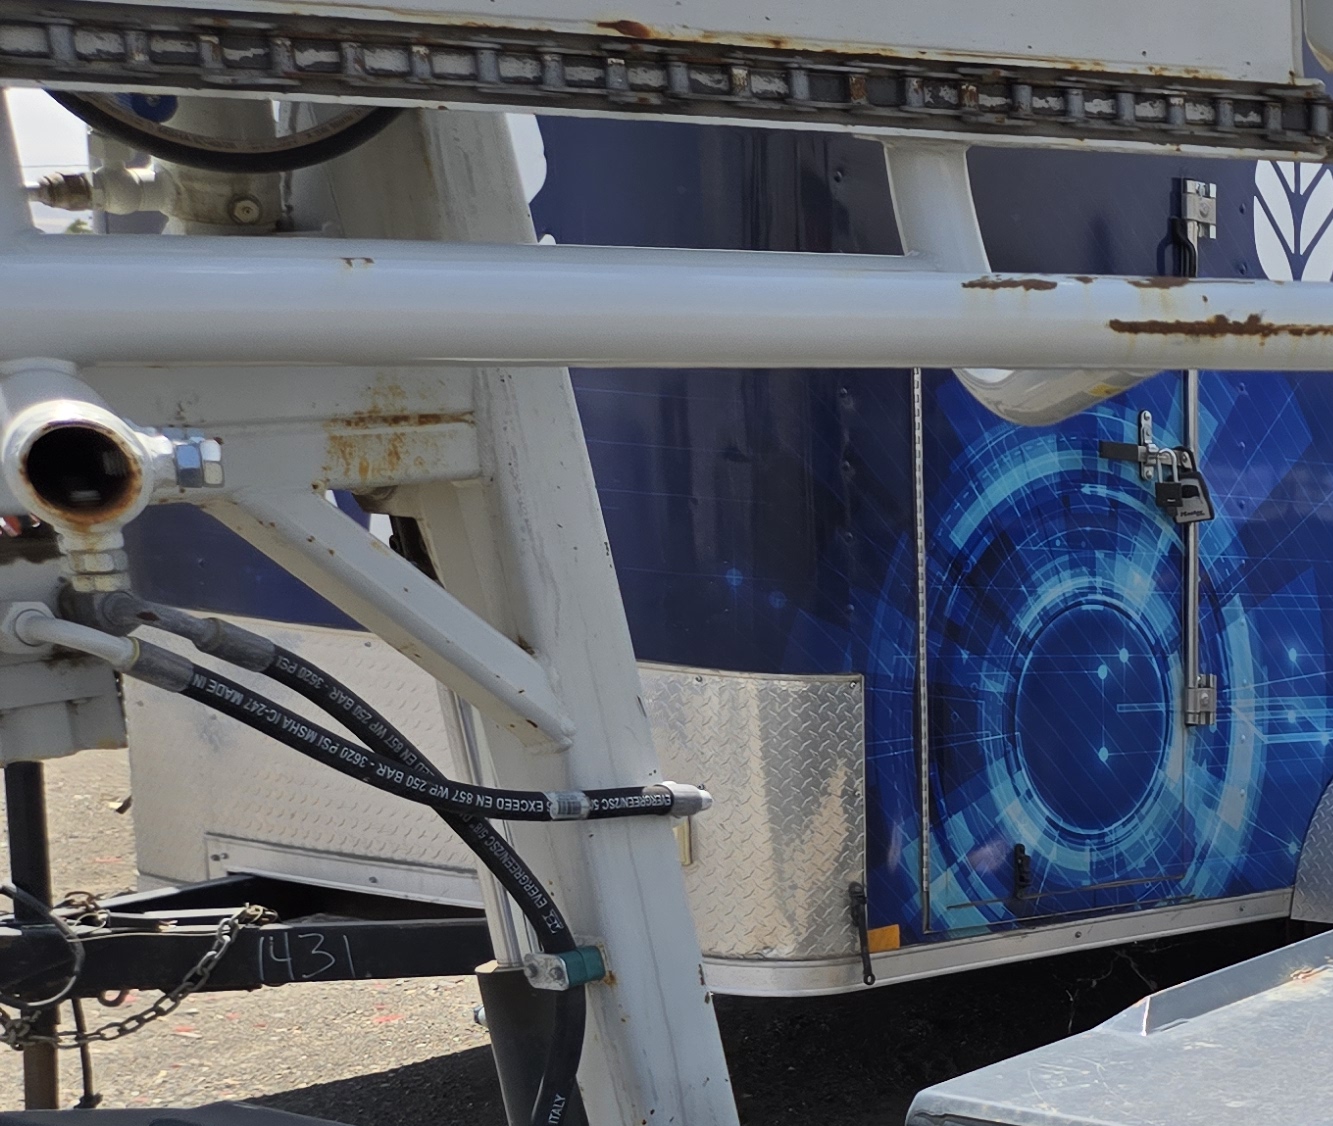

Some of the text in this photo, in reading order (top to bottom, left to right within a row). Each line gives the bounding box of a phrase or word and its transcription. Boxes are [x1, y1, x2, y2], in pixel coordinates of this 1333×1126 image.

[191, 673, 206, 690] IN
[206, 679, 245, 706] MADE
[329, 686, 353, 710] BAR
[243, 698, 283, 723] IC-247
[351, 705, 373, 724] 250
[283, 716, 319, 743] MSHA
[369, 720, 388, 737] WP
[318, 736, 340, 755] PSI
[384, 736, 404, 754] 857
[339, 746, 369, 768] 3620
[376, 763, 405, 784] BAR
[405, 775, 427, 792] 250
[429, 786, 449, 799] WP
[452, 789, 474, 805] 857
[476, 794, 493, 809] EN
[496, 797, 544, 812] EXCEED
[259, 931, 357, 981] 1431
[548, 1092, 566, 1124] ITALY
